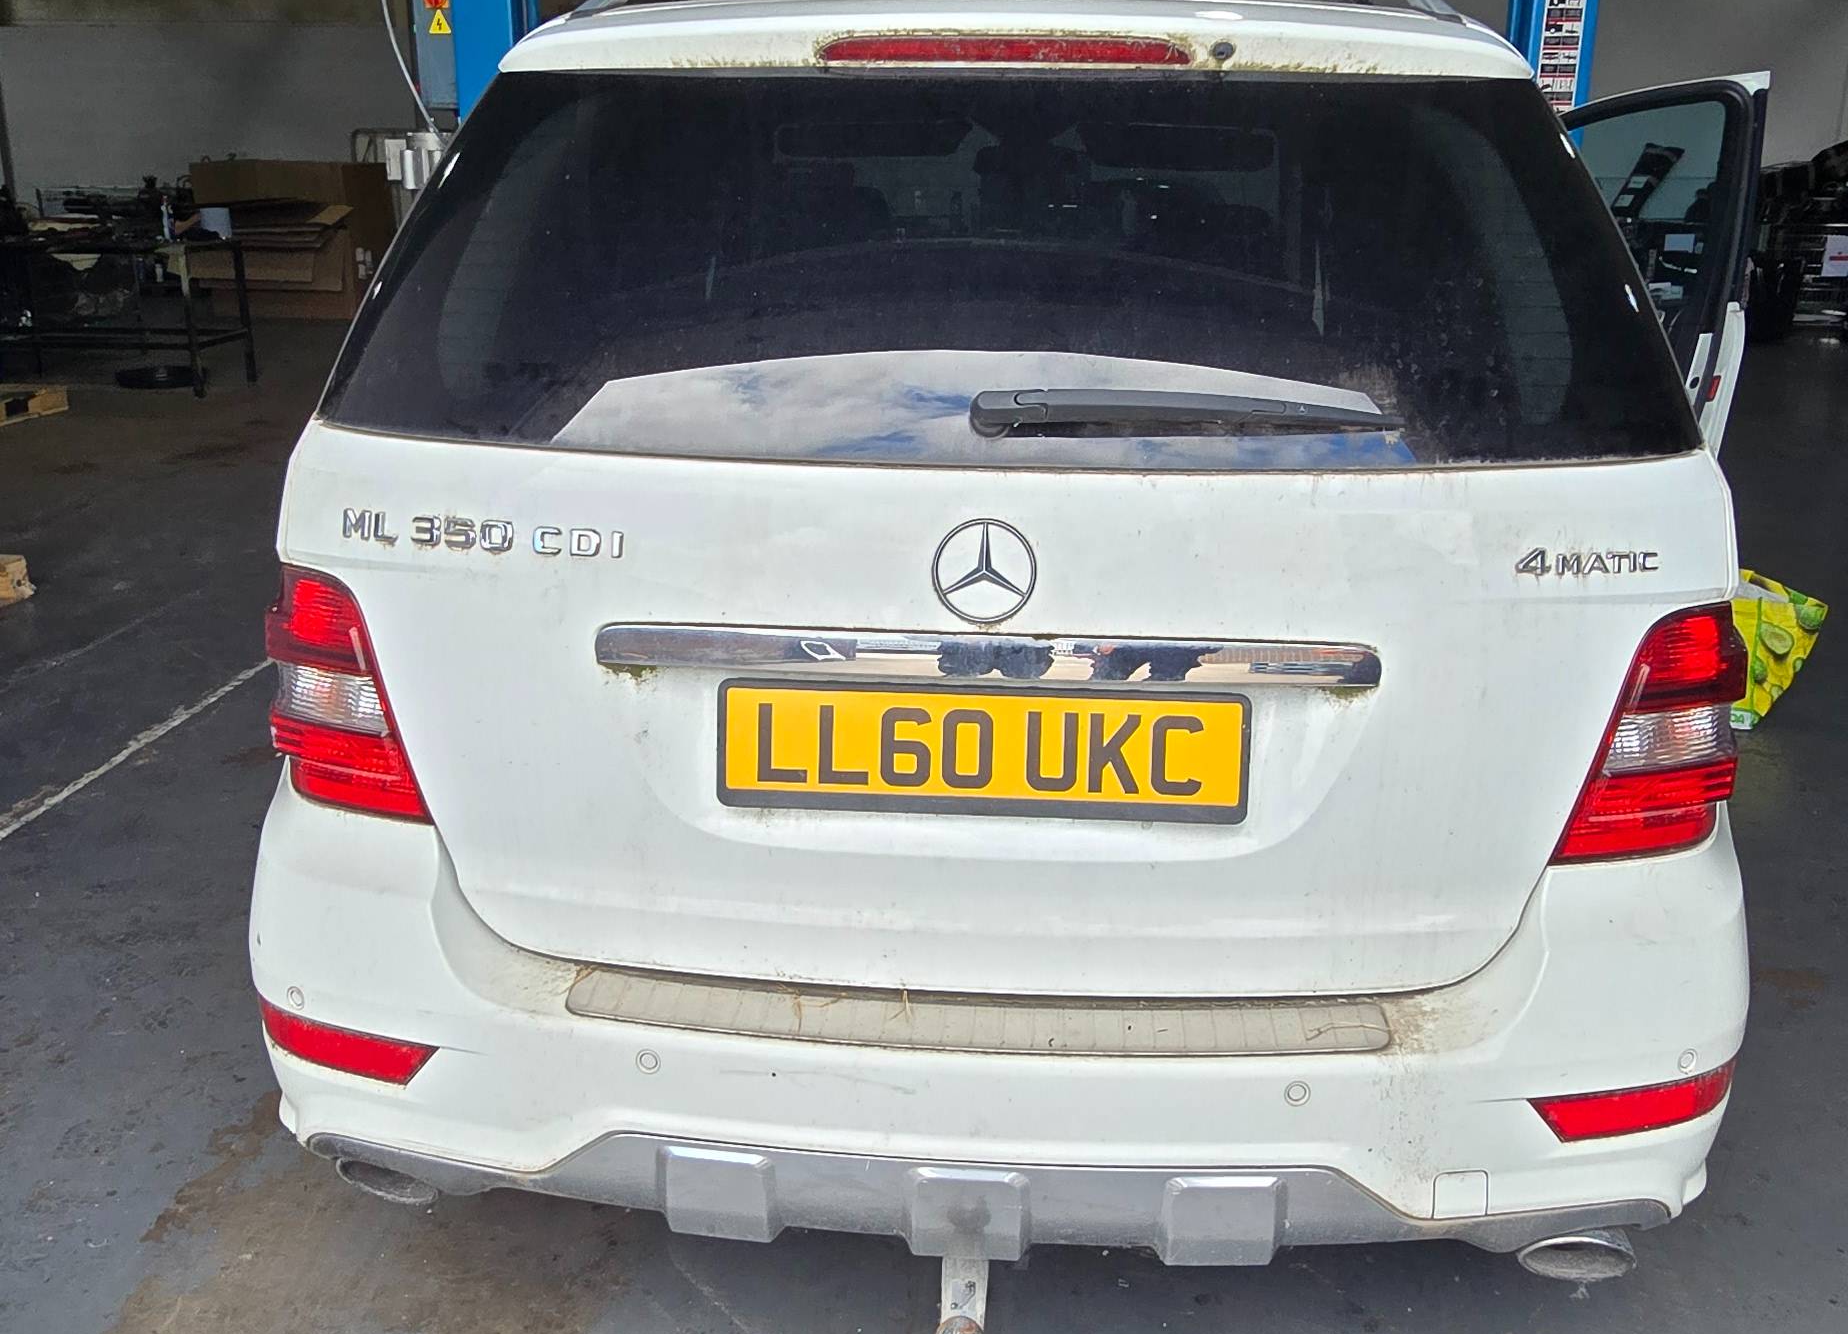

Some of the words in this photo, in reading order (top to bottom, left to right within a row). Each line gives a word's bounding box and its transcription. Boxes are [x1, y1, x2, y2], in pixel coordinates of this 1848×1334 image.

[342, 508, 399, 543] ML
[410, 515, 514, 553] 350
[532, 525, 624, 559] CDI
[757, 702, 995, 789] LL60
[1025, 710, 1205, 796] UKC
